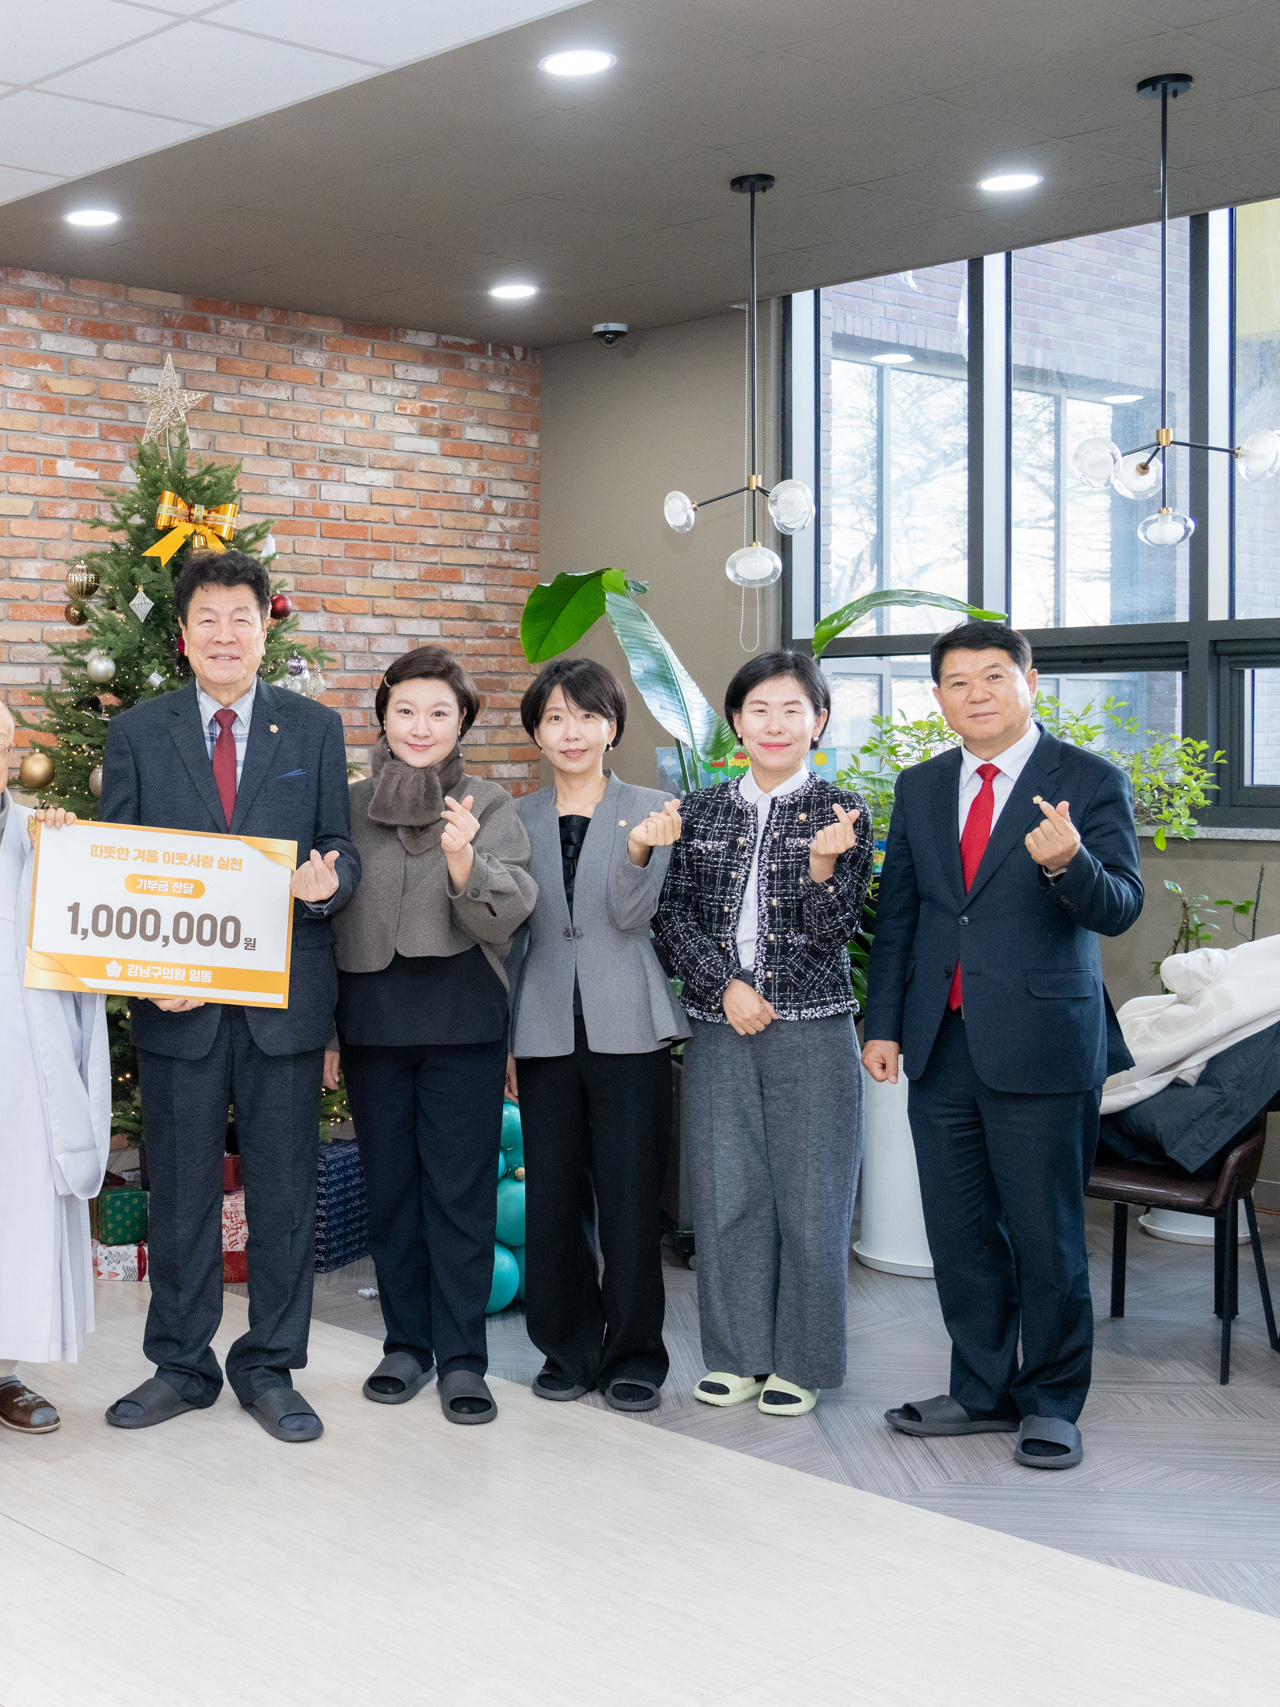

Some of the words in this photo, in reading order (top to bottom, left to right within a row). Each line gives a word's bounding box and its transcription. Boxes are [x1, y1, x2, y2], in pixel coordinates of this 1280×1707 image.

[728, 756, 751, 769] dupl
[90, 844, 130, 861] 따뜻한
[132, 848, 159, 864] 겨울
[162, 851, 214, 869] 이웃사랑
[217, 856, 243, 872] 실천
[136, 878, 169, 893] 기부금
[171, 881, 195, 895] 전달
[126, 963, 186, 981] 강남구의원
[189, 968, 213, 983] 일동
